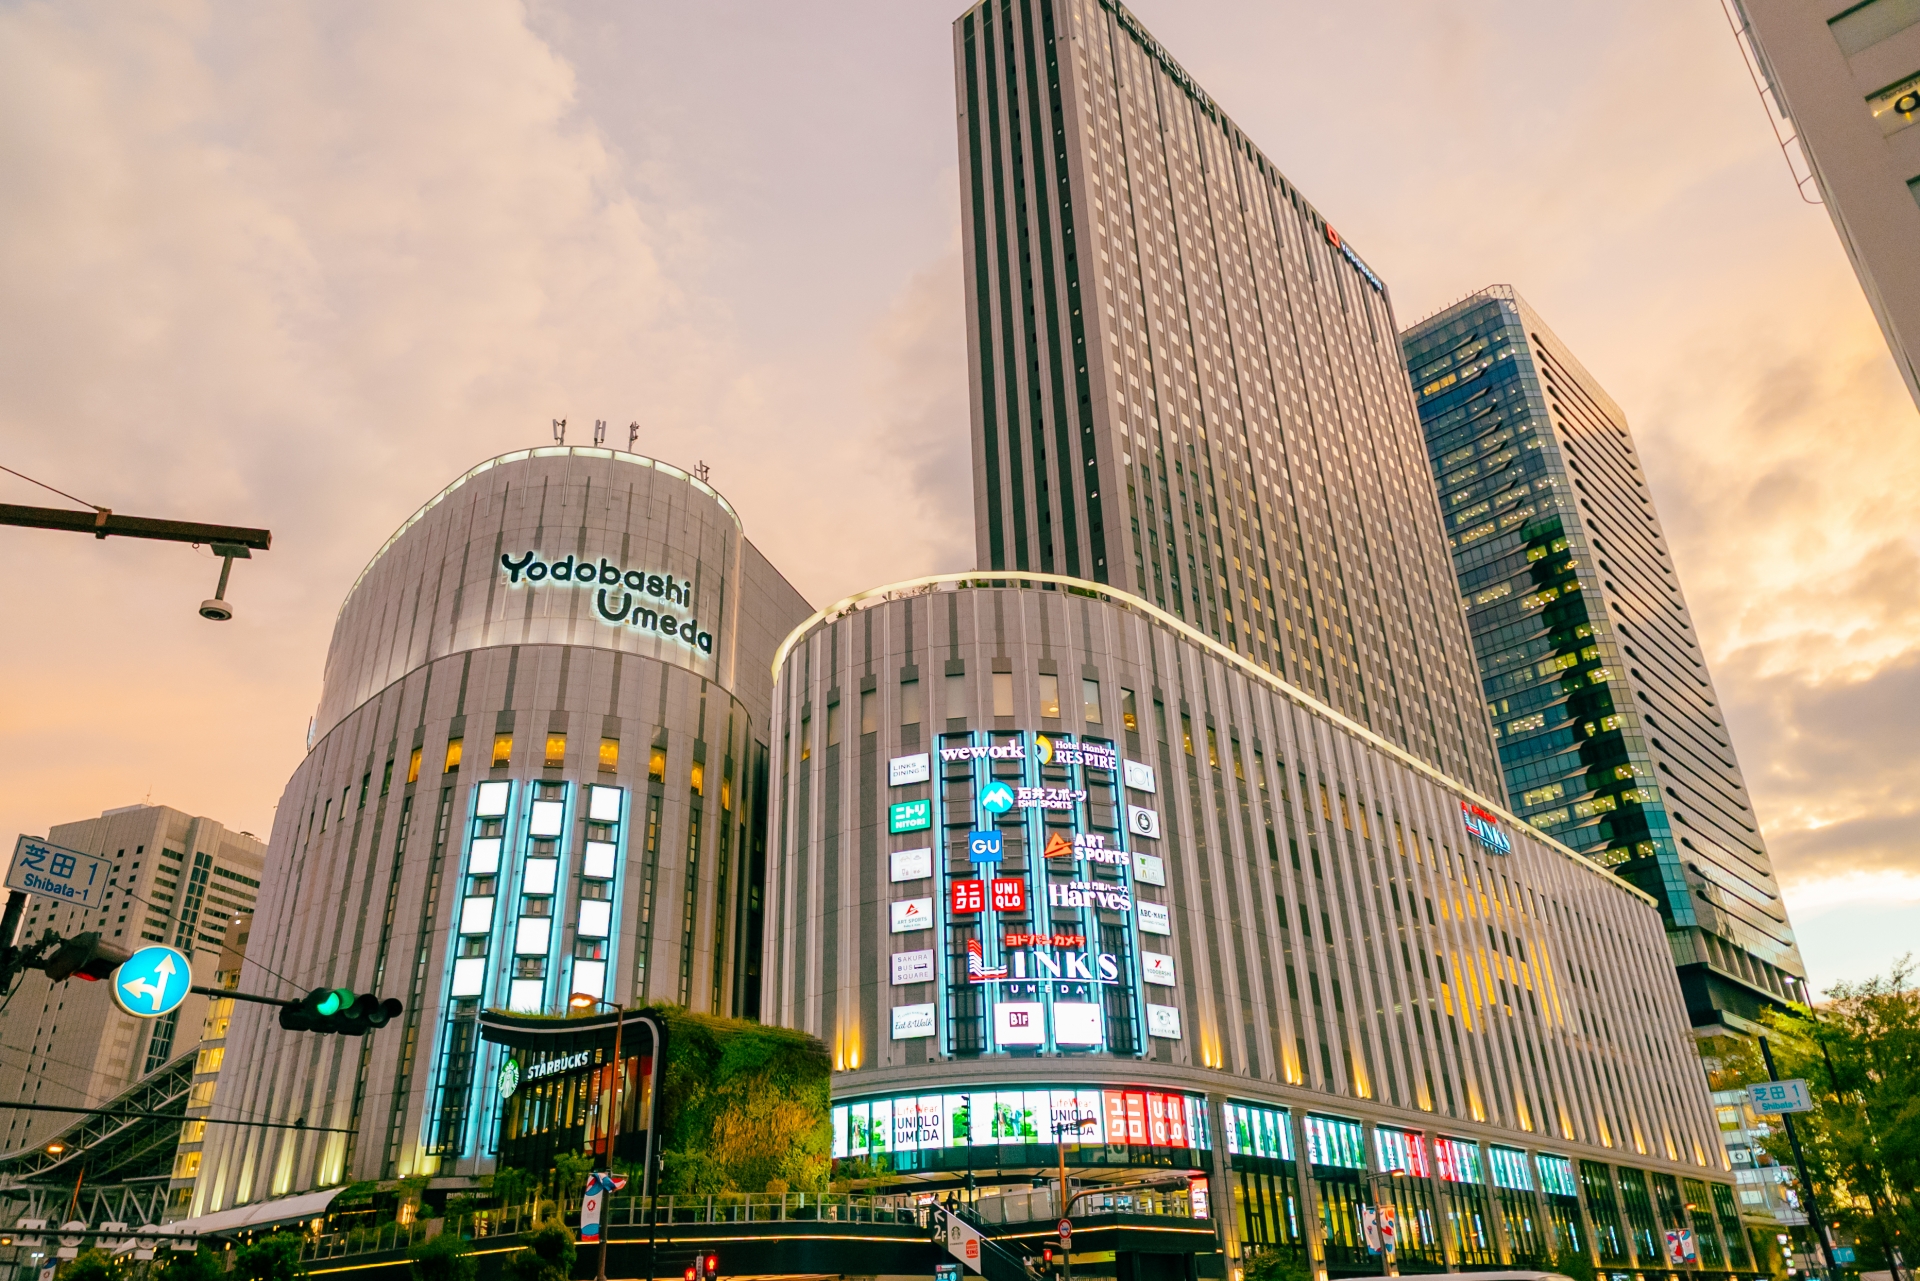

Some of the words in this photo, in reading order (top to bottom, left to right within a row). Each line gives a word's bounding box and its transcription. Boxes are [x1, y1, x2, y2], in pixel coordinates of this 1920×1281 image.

[1154, 41, 1214, 114] RESPIRE
[501, 551, 691, 608] Yodobashi
[597, 589, 712, 654] Umeda
[940, 739, 1025, 761] wework
[1055, 740, 1080, 750] Hotel
[1082, 743, 1115, 756] Hankyu
[893, 762, 917, 771] LINKS
[1055, 750, 1117, 770] RESPIRE
[893, 768, 920, 777] DINING
[1018, 787, 1086, 801] 石井スポーツ
[895, 803, 925, 820] ニトリ
[1018, 800, 1038, 808] ISHII
[1041, 800, 1072, 809] SPORTS
[895, 817, 926, 829] NITORI
[972, 839, 1000, 854] GU
[1075, 833, 1104, 848] ART
[1075, 847, 1130, 865] SPORTS
[20, 844, 76, 879] 芝田
[88, 862, 98, 885] 1
[23, 873, 89, 900] Shibata-1
[995, 883, 1018, 895] UNI
[995, 895, 1021, 908] QLO
[1048, 884, 1131, 910] Harves
[908, 916, 928, 924] SPORTS
[1006, 934, 1085, 947] ヨドバシカメラ
[898, 954, 928, 963] SAKURA
[968, 940, 1118, 981] LINKS
[898, 972, 929, 981] SQUARE
[1011, 984, 1084, 994] UMEDA
[528, 1051, 588, 1080] STARBUCKS
[1753, 1086, 1785, 1101] 芝田
[1792, 1084, 1799, 1097] 1
[1762, 1100, 1801, 1110] Shibata-1
[897, 1115, 939, 1130] UNIQLO
[934, 1224, 947, 1242] 2F
